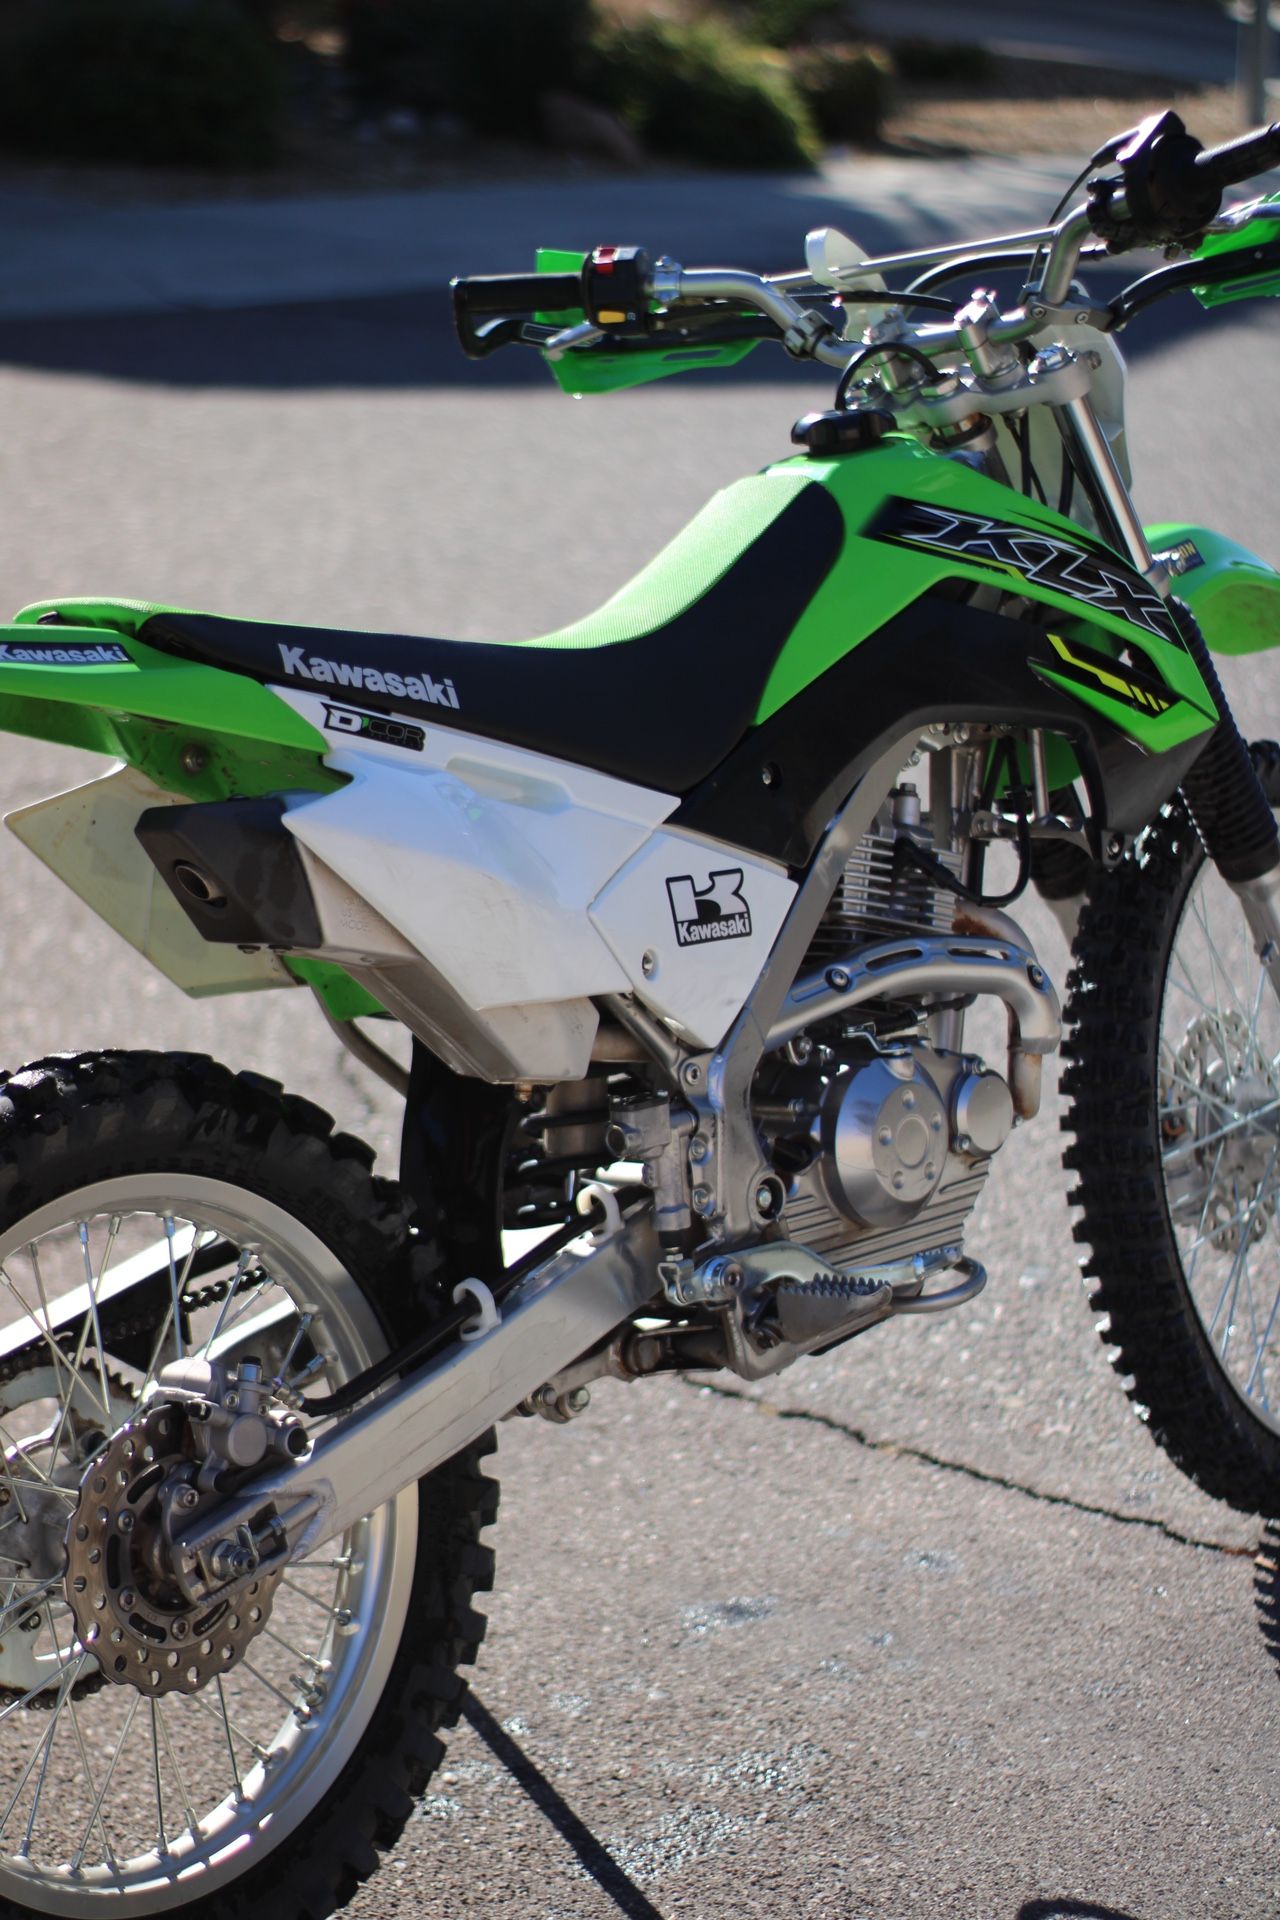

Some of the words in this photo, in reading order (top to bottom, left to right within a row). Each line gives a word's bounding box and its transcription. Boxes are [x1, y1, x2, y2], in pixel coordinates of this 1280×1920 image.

[902, 504, 1172, 643] KLX
[0, 644, 129, 662] Kawasaki
[277, 643, 461, 710] Kawasaki
[677, 912, 751, 944] Kawasaki
